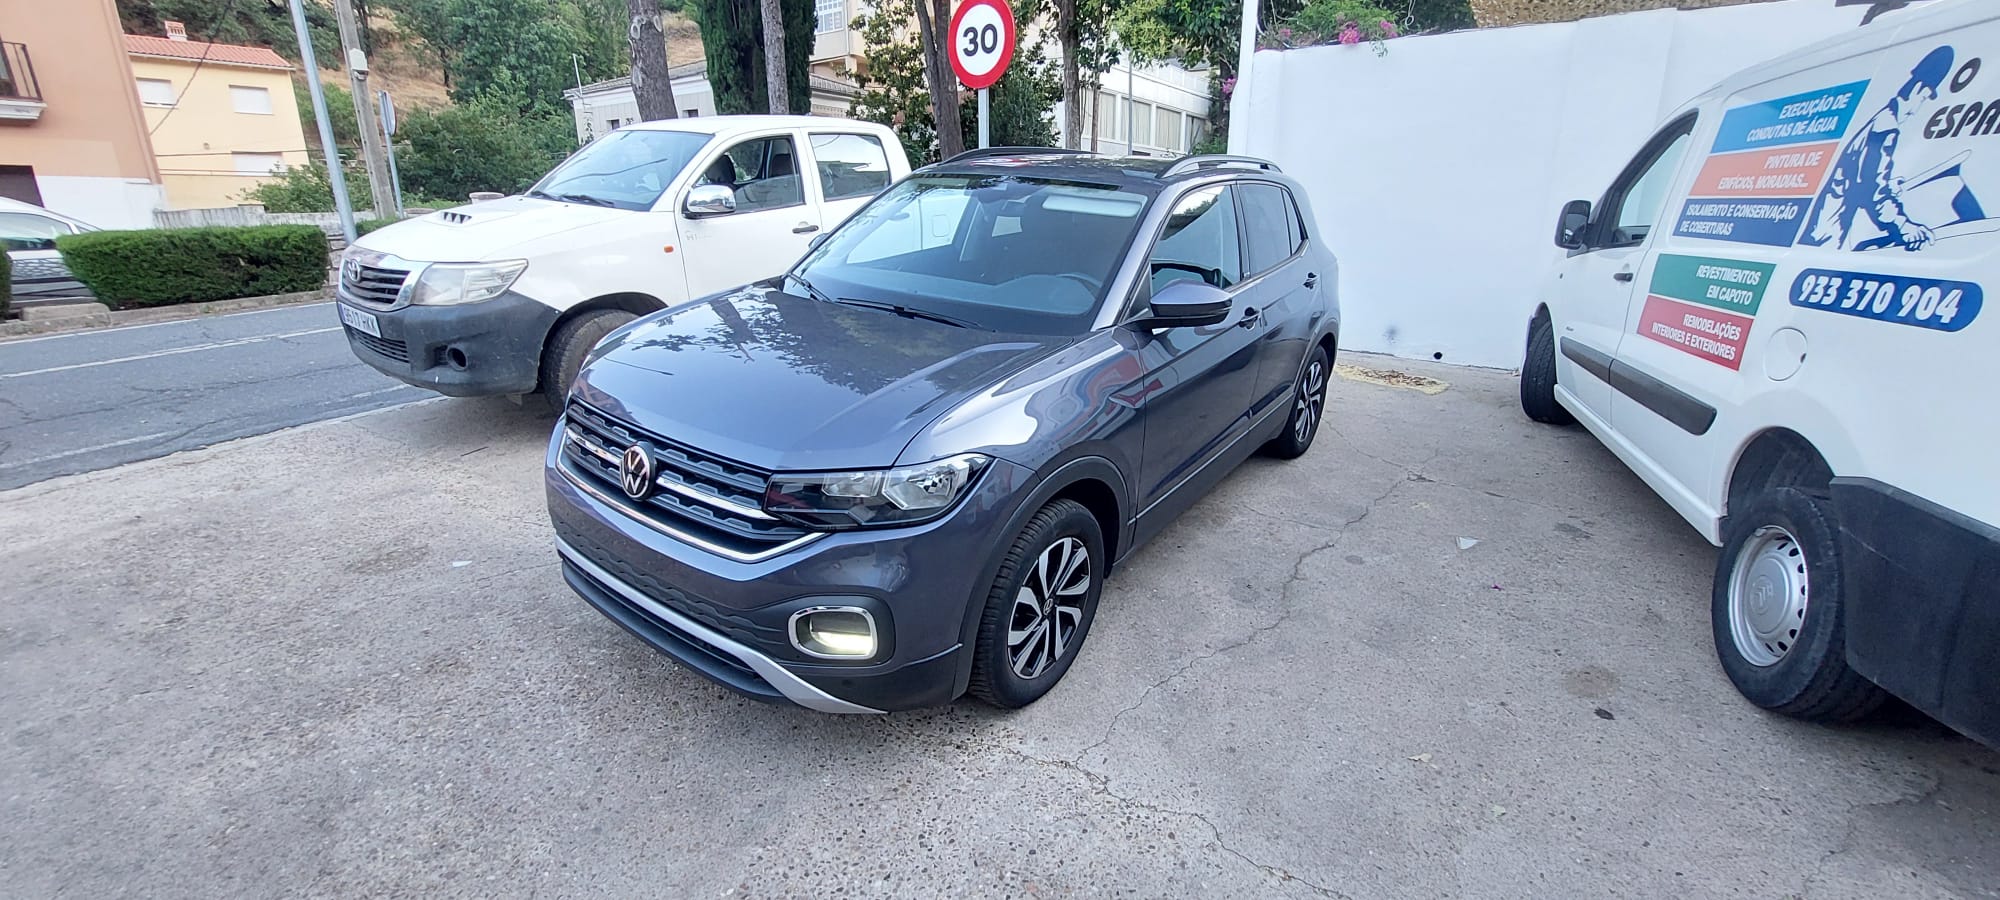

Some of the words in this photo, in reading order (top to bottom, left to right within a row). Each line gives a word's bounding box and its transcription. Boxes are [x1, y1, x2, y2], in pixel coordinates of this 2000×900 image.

[963, 23, 998, 57] 30
[1949, 57, 1982, 93] O
[1778, 95, 1832, 120] EXECUÇÃO
[1831, 92, 1853, 110] DE
[1746, 122, 1793, 142] CONDUTAS
[1791, 120, 1809, 136] DE
[1806, 115, 1839, 133] ÁGUA
[1763, 153, 1806, 169] PINTURA
[1804, 151, 1825, 167] DE
[1686, 204, 1728, 217] ISOLAMENTO
[1726, 204, 1735, 217] E
[1733, 202, 1799, 223] CONSERVAÇÃO
[1679, 220, 1690, 232] DE
[1688, 221, 1735, 236] COBERTURAS
[1696, 265, 1761, 285] REVESTIMENTOS
[1706, 285, 1719, 299] EM
[1719, 287, 1753, 305] CAPOTO
[1798, 274, 1843, 305] 933
[1840, 279, 1896, 314] 370
[1897, 284, 1964, 324] 904
[1651, 322, 1685, 344] INTERIORES
[1684, 333, 1692, 345] E
[1690, 335, 1736, 360] EXTERIORES
[1683, 314, 1742, 341] REMODELAÇÕES
